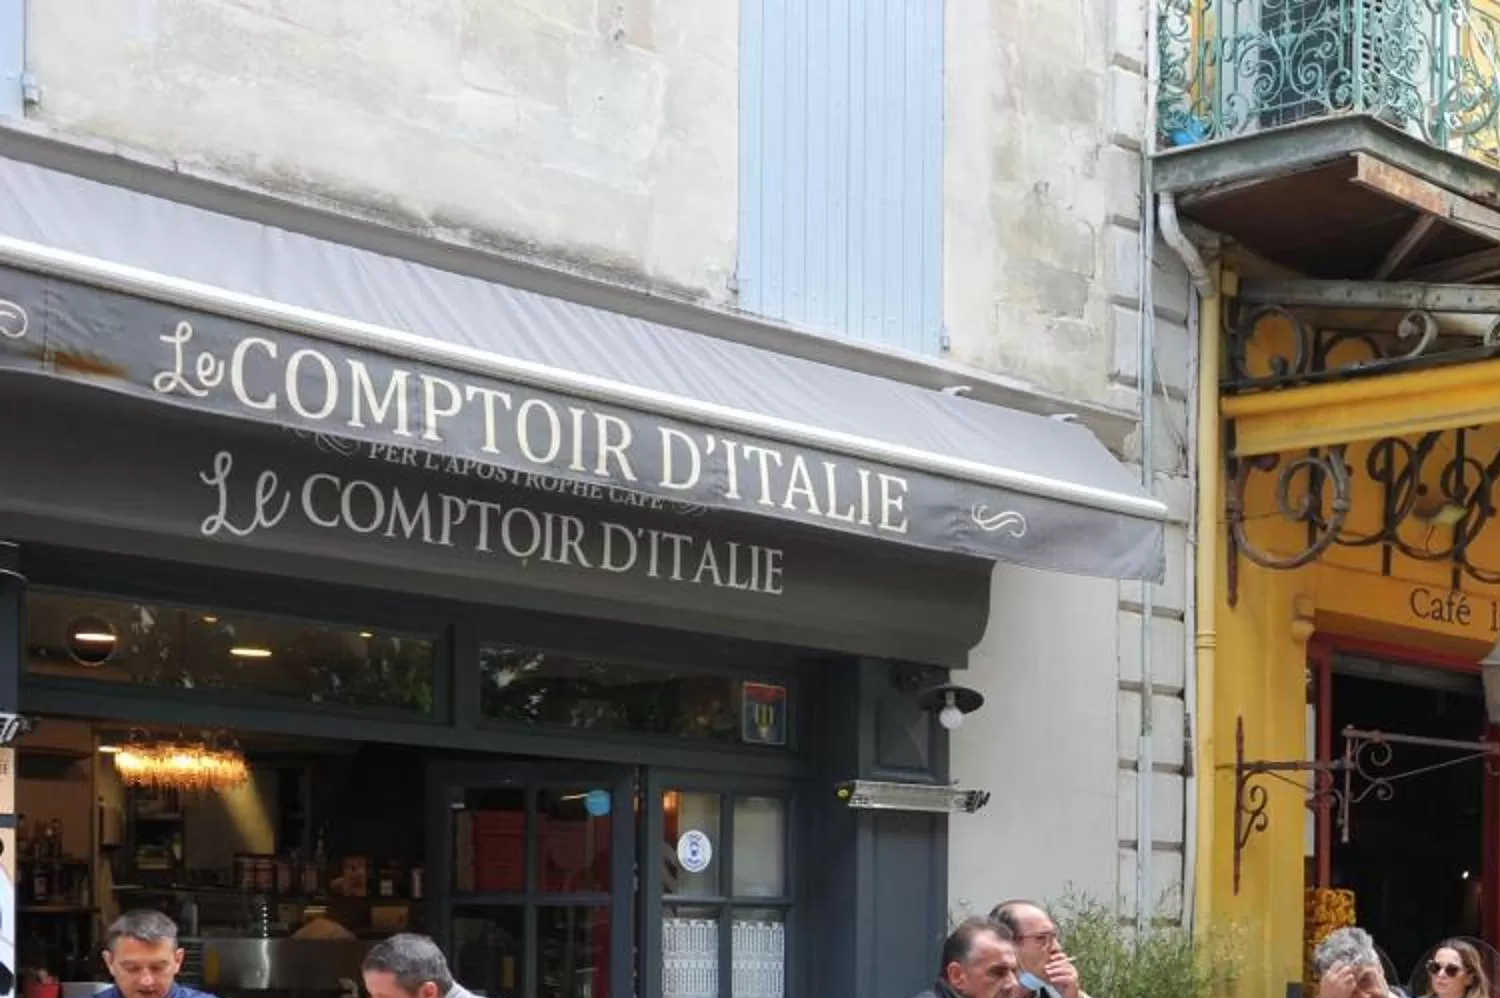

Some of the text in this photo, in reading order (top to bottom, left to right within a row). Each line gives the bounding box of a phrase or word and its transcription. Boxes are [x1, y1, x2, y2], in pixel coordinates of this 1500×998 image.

[152, 320, 910, 534] Le COMPTOIR D'ITALIE
[200, 450, 784, 596] Le COMPTOIR D'ITALIE
[1408, 587, 1472, 627] Café
